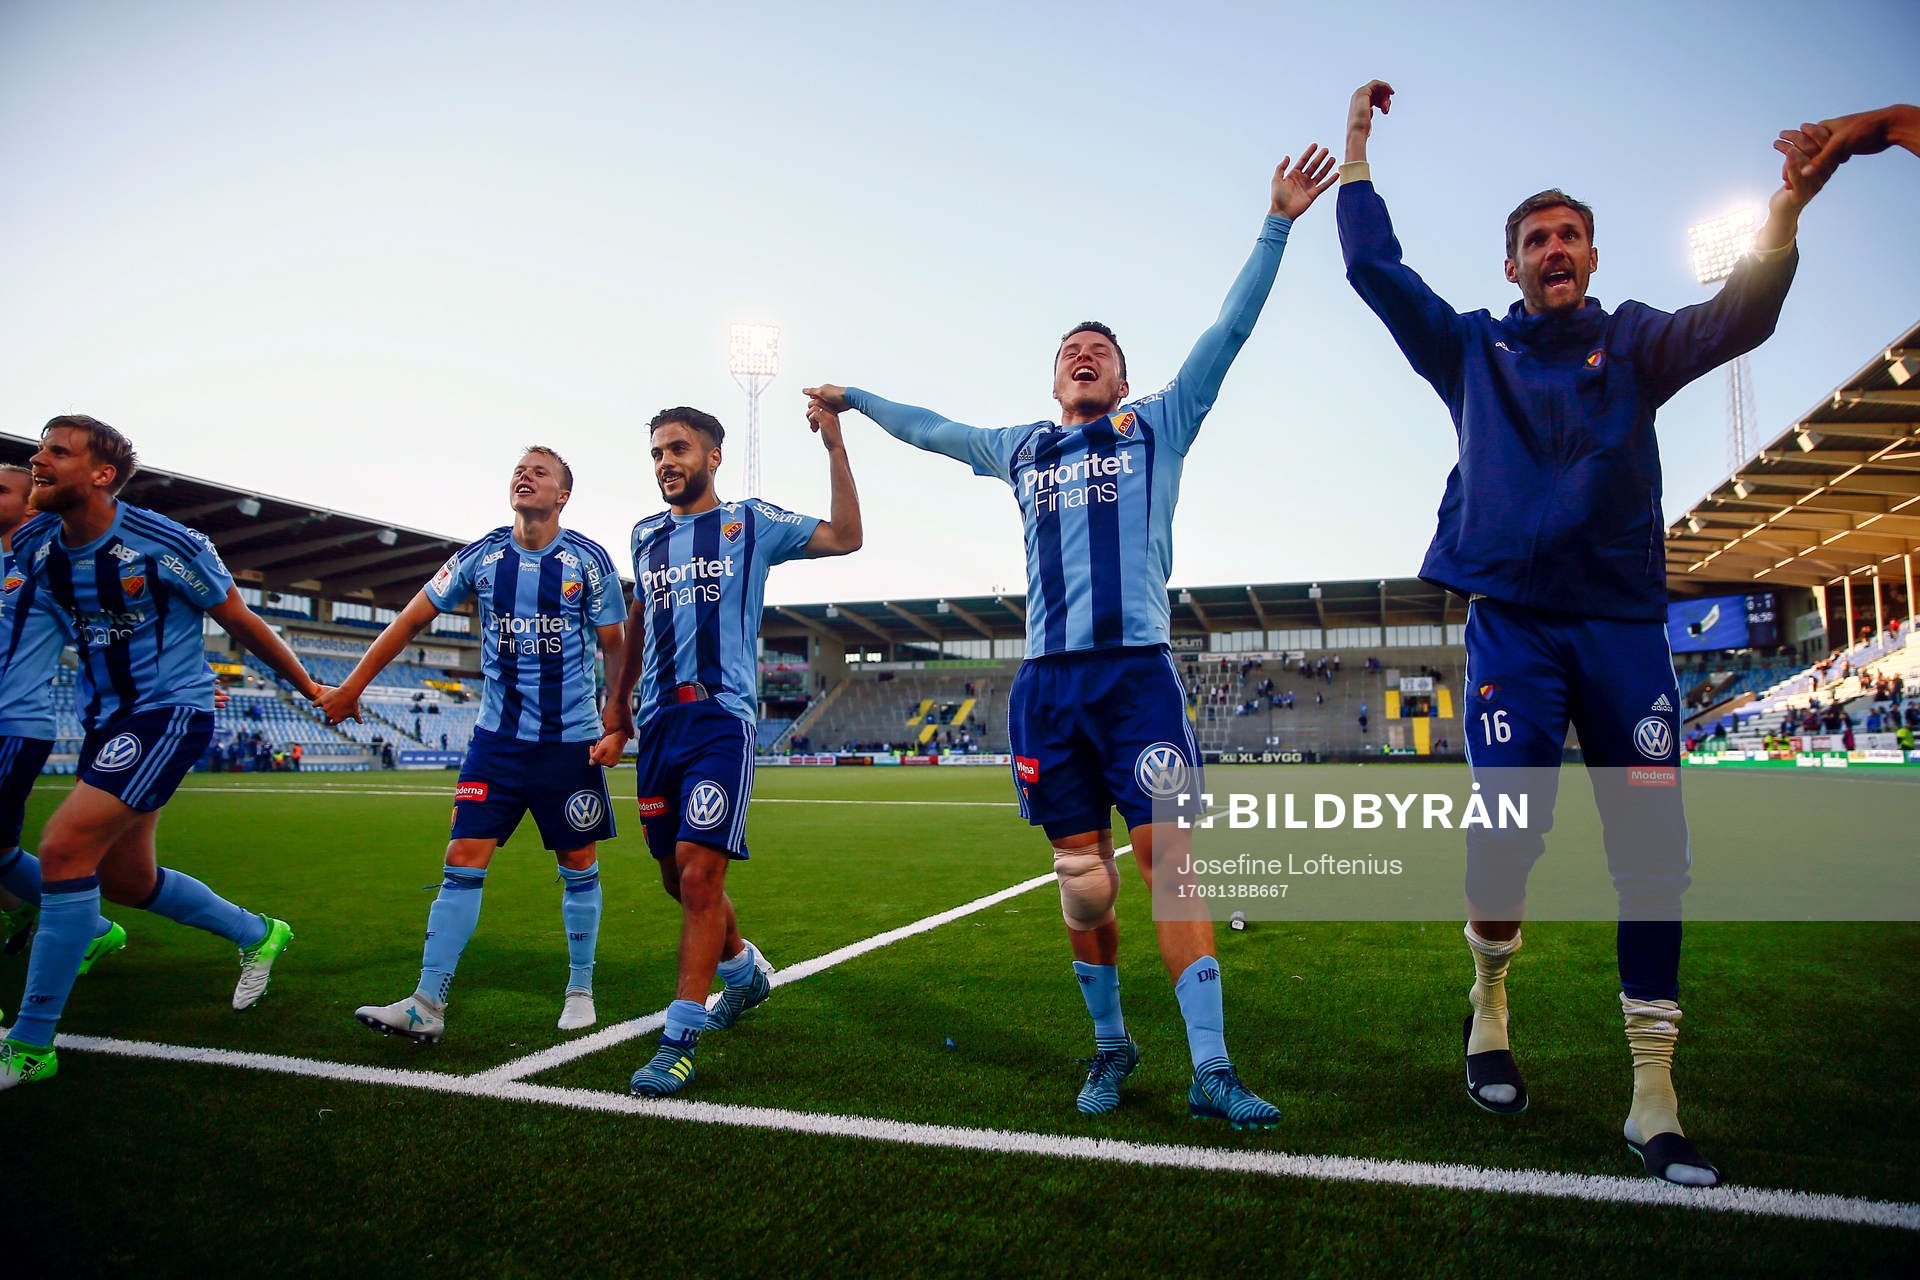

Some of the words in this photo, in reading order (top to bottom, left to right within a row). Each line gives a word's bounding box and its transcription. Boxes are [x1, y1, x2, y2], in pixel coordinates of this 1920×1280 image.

[1023, 451, 1133, 496] Prioritet
[1035, 482, 1118, 517] Finans
[159, 554, 210, 596] stadium
[642, 555, 734, 591] Prioritet
[652, 584, 720, 613] Finans
[489, 613, 572, 634] Prioritet
[498, 634, 562, 655] Finans
[1480, 709, 1511, 746] 16
[1239, 753, 1302, 763] XL-BYGG
[456, 786, 483, 796] oderna
[1197, 967, 1220, 983] DIF
